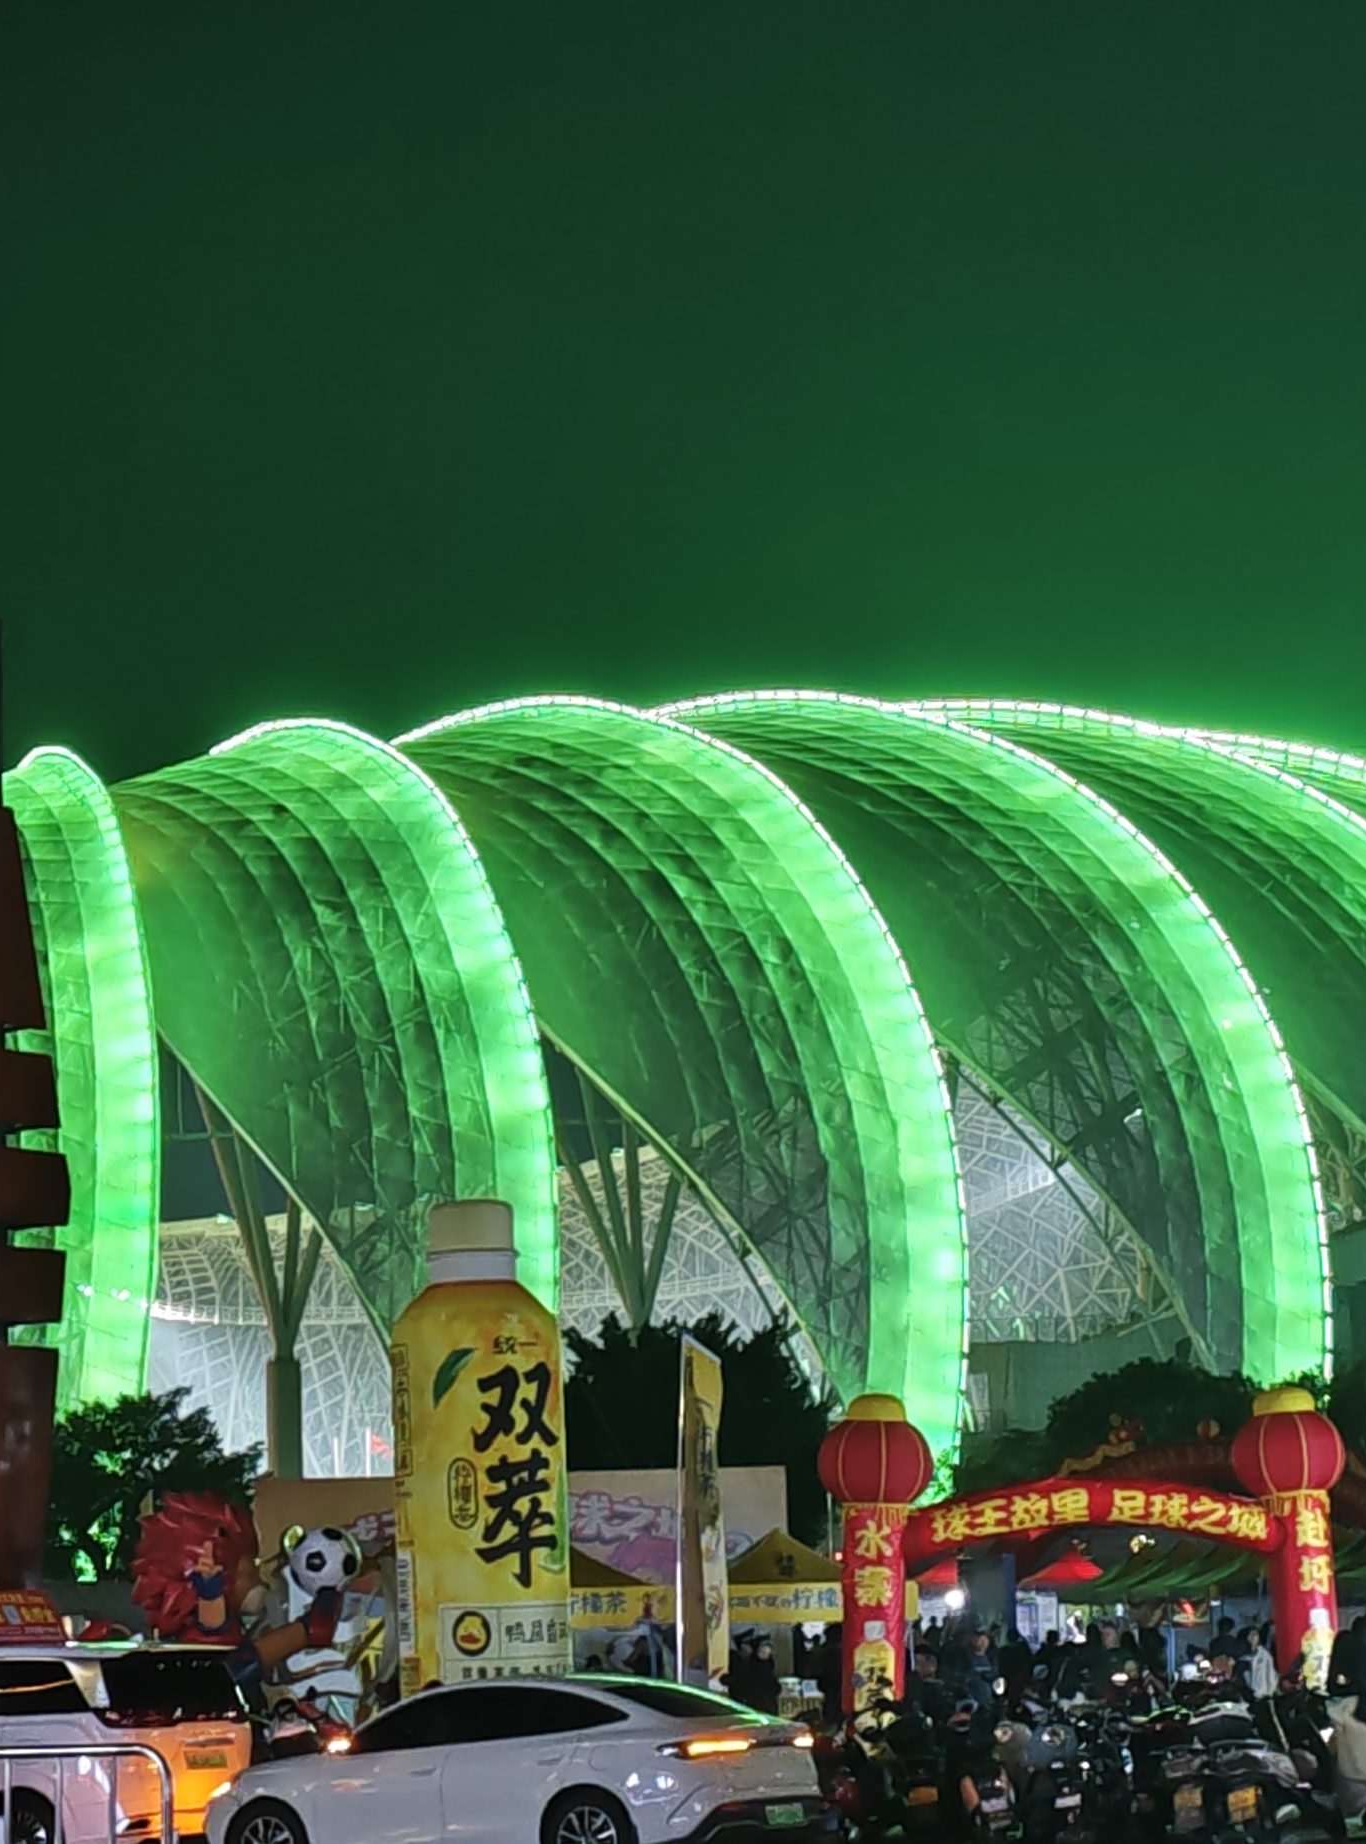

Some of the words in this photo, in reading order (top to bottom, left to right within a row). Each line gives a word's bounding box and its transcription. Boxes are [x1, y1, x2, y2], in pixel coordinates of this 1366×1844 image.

[492, 1335, 538, 1356] 统一
[471, 1360, 559, 1589] 双萃
[931, 1487, 1090, 1543] 球王故里
[1108, 1488, 1268, 1540] 足球之城
